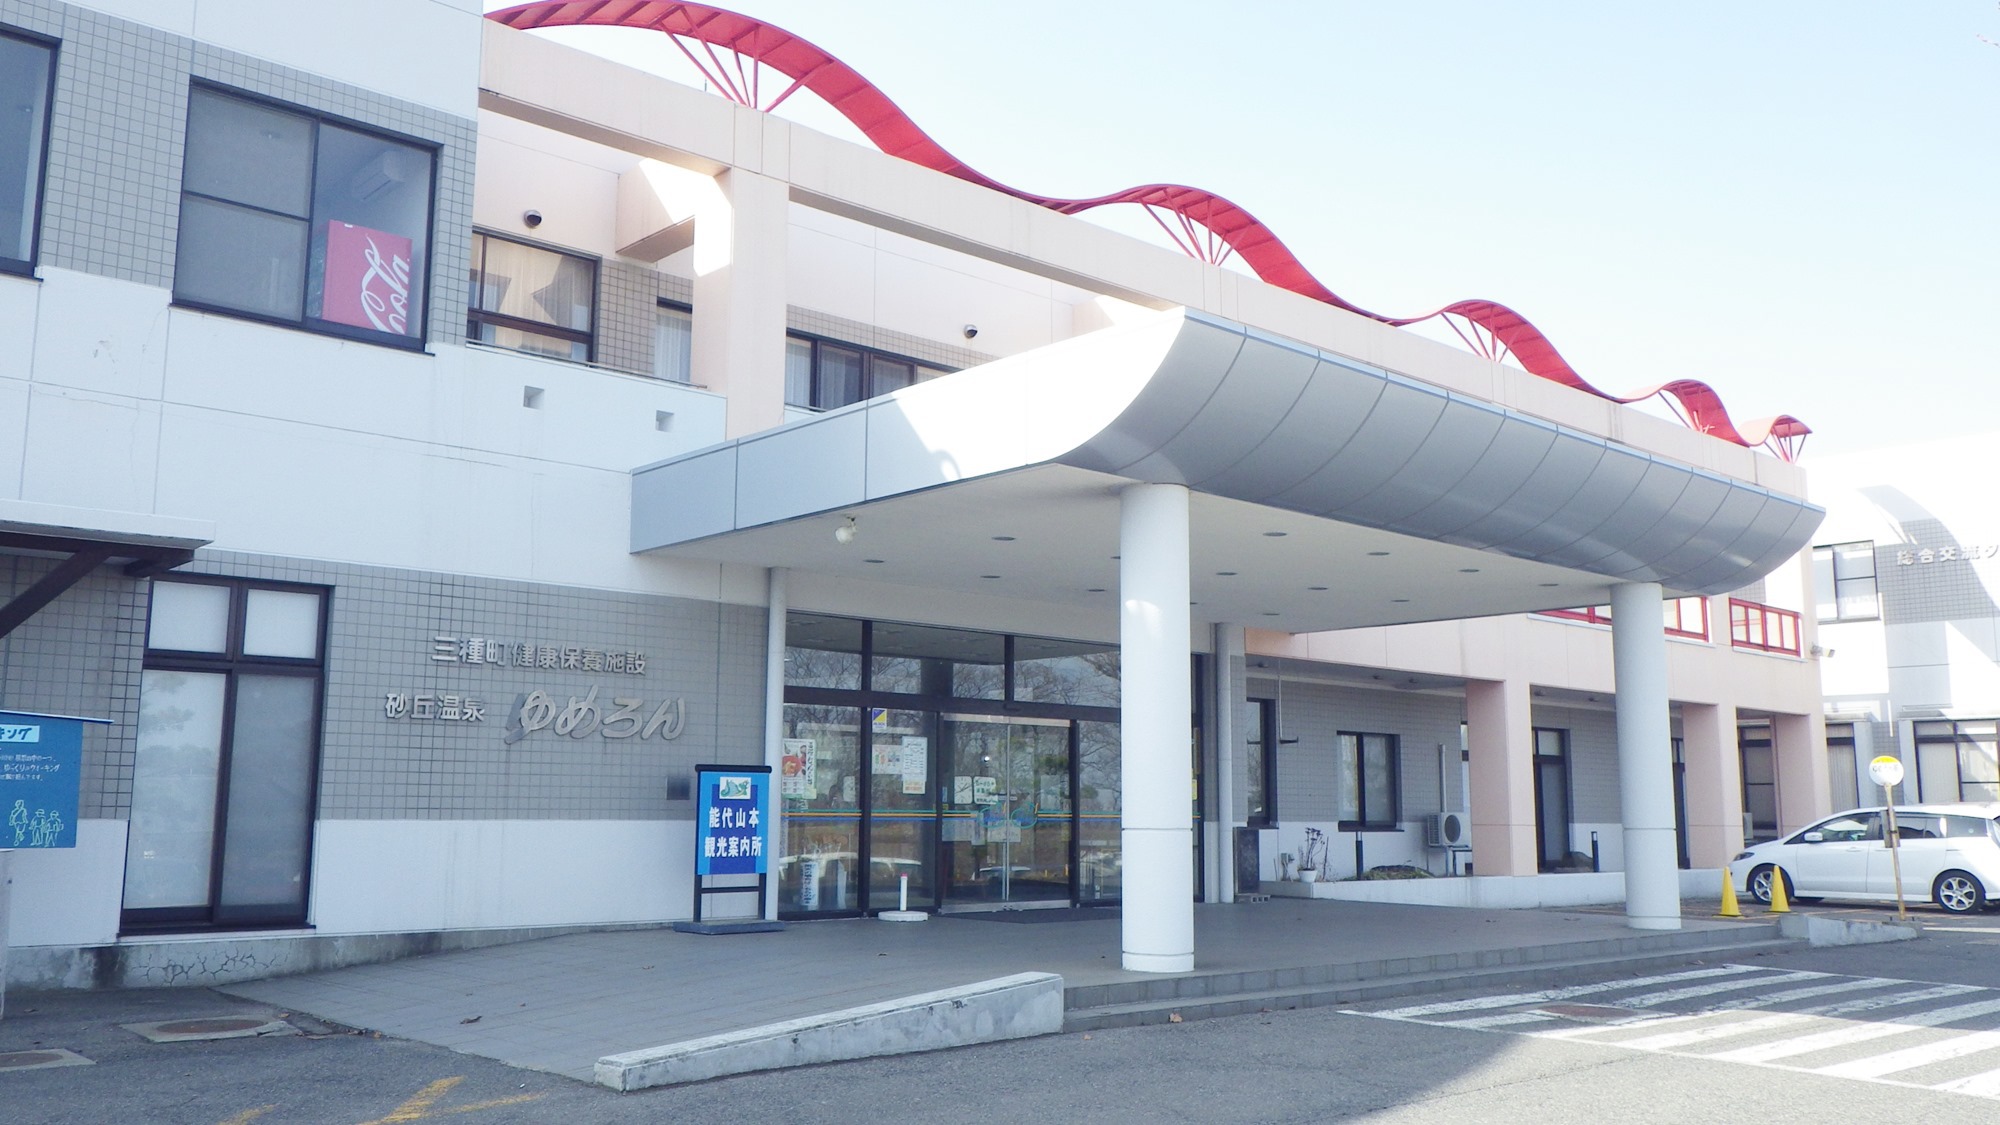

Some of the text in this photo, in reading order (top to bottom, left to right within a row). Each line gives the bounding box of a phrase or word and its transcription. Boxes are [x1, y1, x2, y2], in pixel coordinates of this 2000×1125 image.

[385, 684, 686, 745] 砂丘温泉 ゆめろん
[708, 806, 760, 829] 能代山本
[704, 836, 763, 858] 観光案内所
